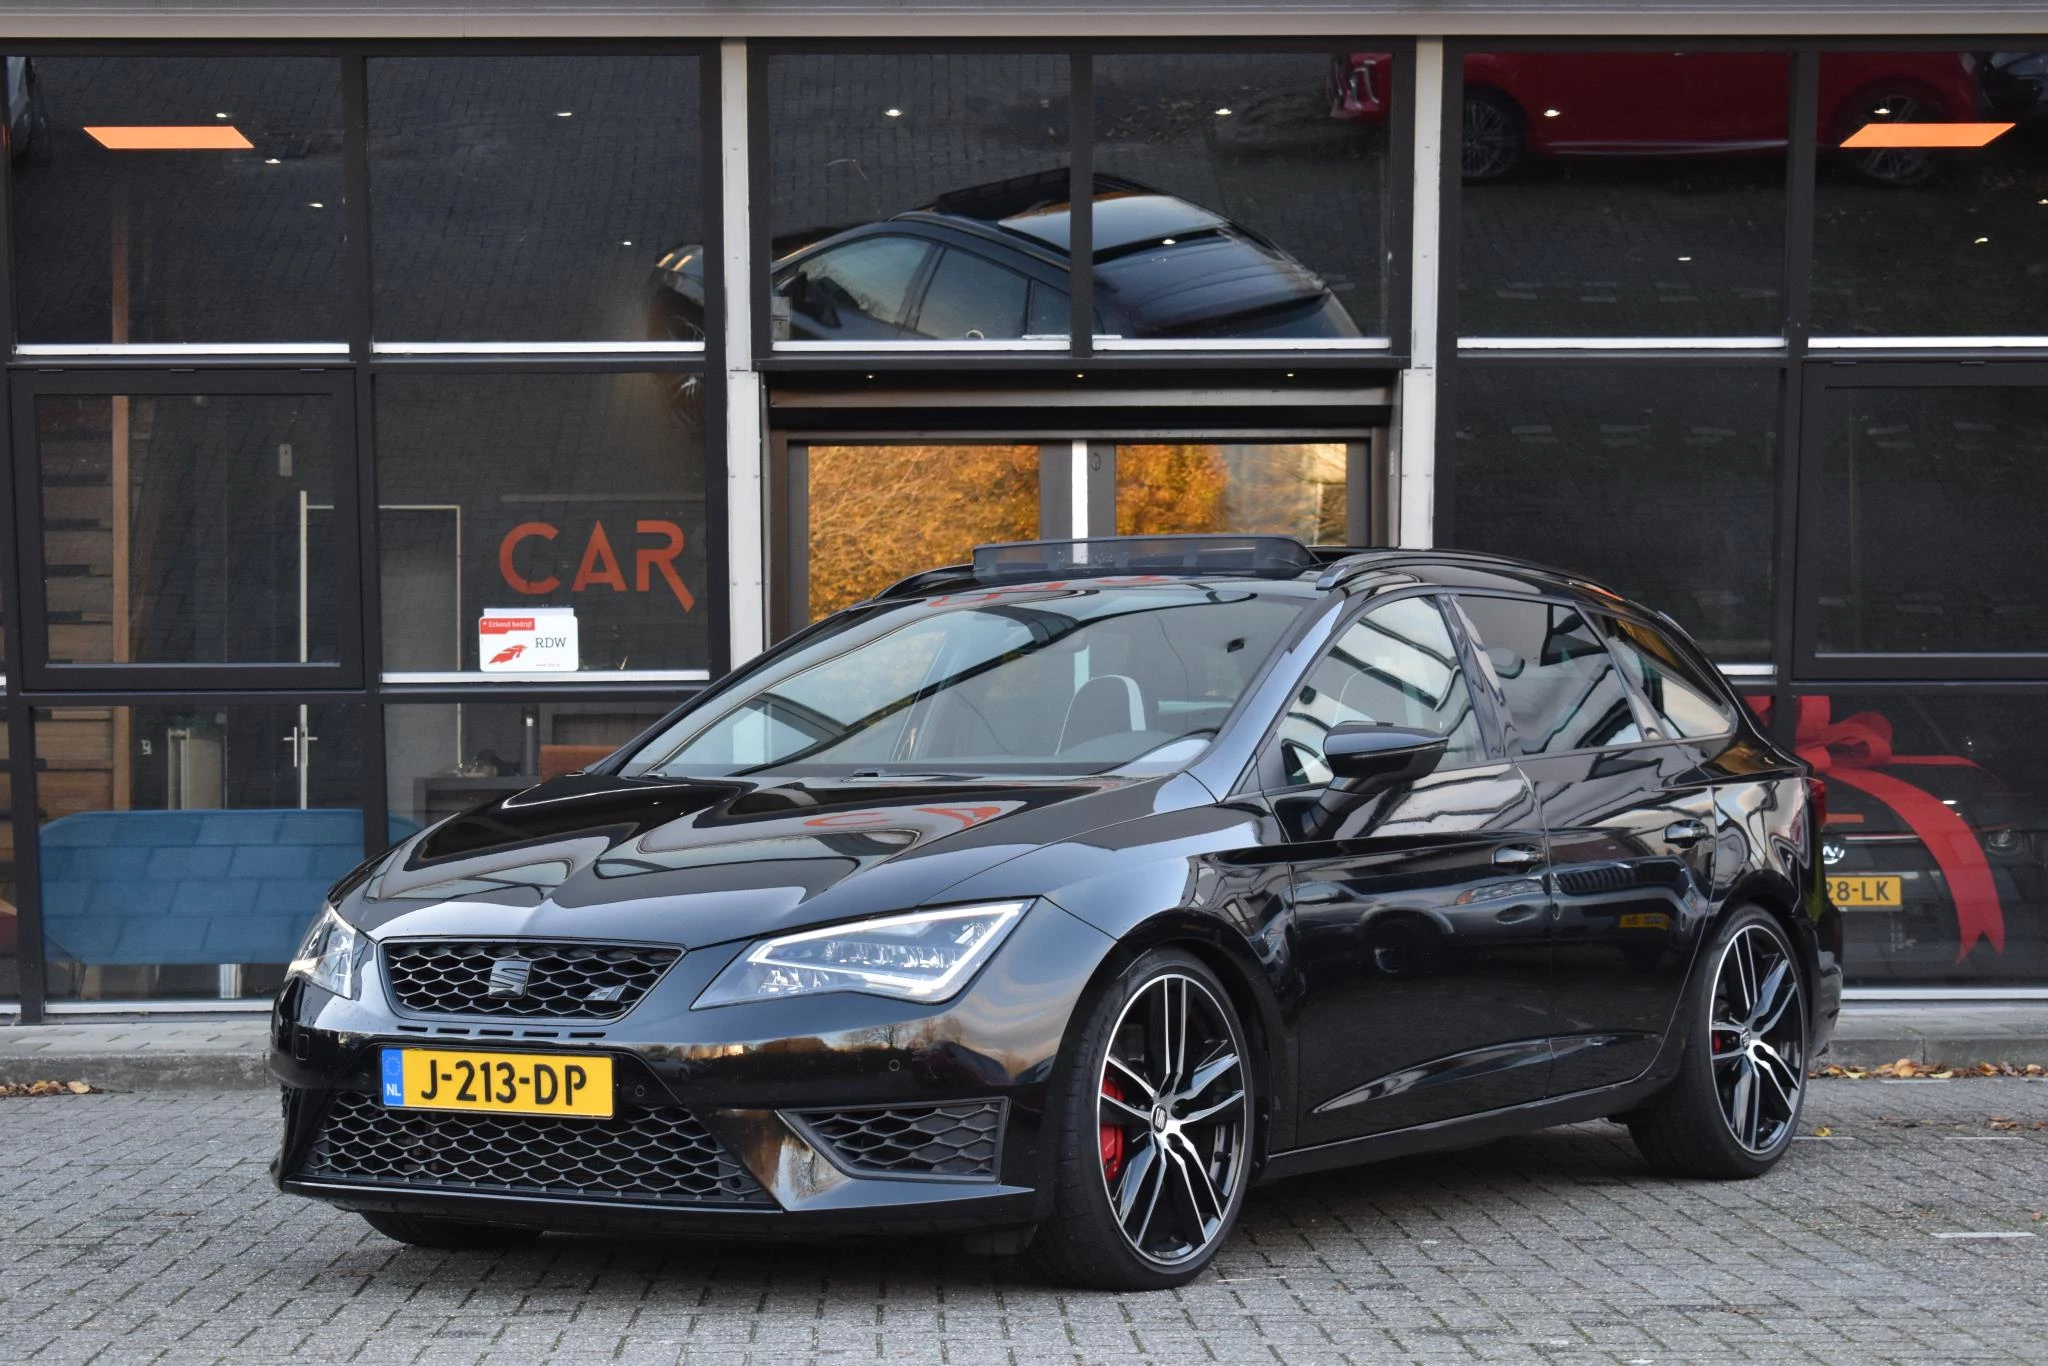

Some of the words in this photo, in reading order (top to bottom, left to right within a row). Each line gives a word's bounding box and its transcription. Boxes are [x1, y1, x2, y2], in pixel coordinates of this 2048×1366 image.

[499, 519, 695, 613] CAR
[488, 620, 511, 628] Erkend
[535, 637, 567, 649] RDW
[386, 1083, 402, 1097] NL
[420, 1059, 587, 1106] J-213-DP
